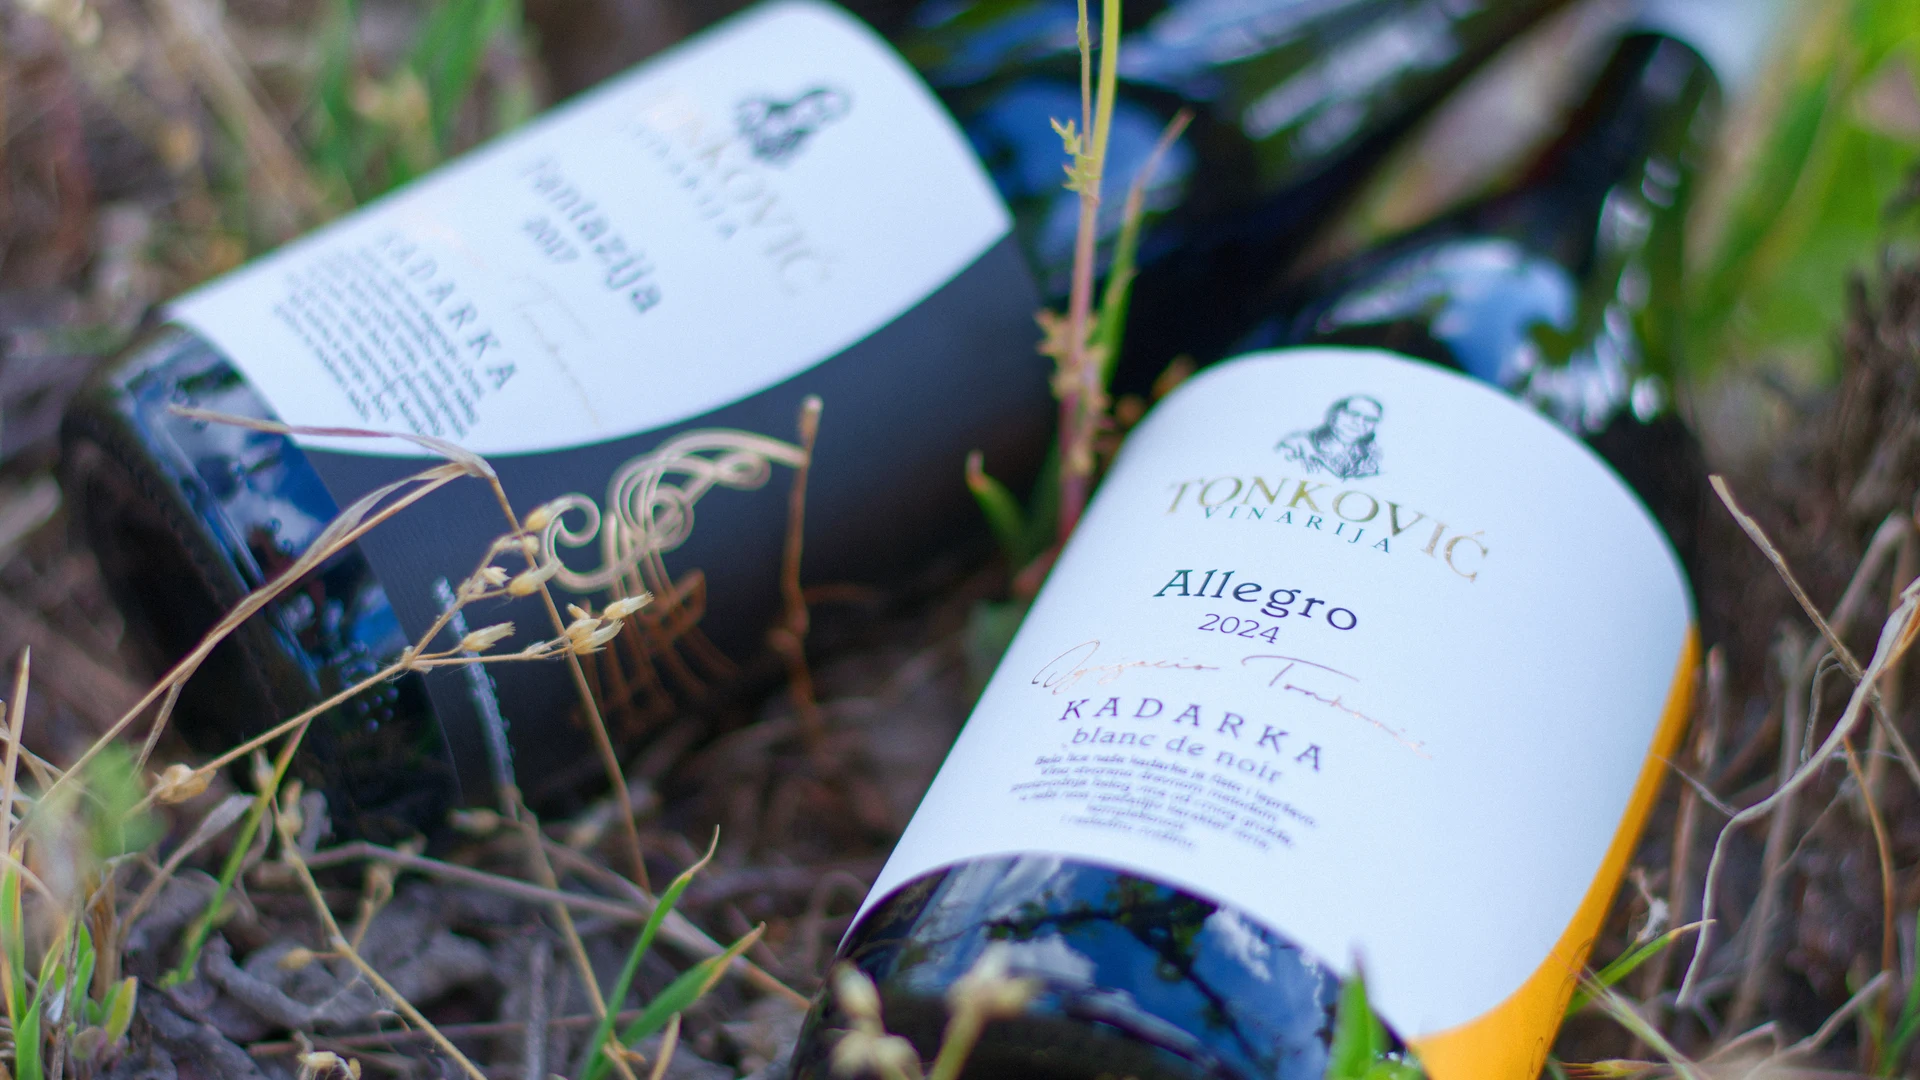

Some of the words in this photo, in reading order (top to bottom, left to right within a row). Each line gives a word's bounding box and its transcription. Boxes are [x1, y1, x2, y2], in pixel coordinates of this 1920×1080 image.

[517, 155, 662, 315] Fantazija
[1164, 475, 1489, 584] TONKOVIĆ
[1204, 505, 1391, 553] VINARIJA
[1153, 568, 1358, 631] Allegro
[1197, 612, 1281, 645] 2024
[1058, 696, 1322, 772] KADARKA
[1071, 726, 1156, 748] blanc
[1165, 734, 1205, 757] de
[1216, 750, 1283, 784] noir
